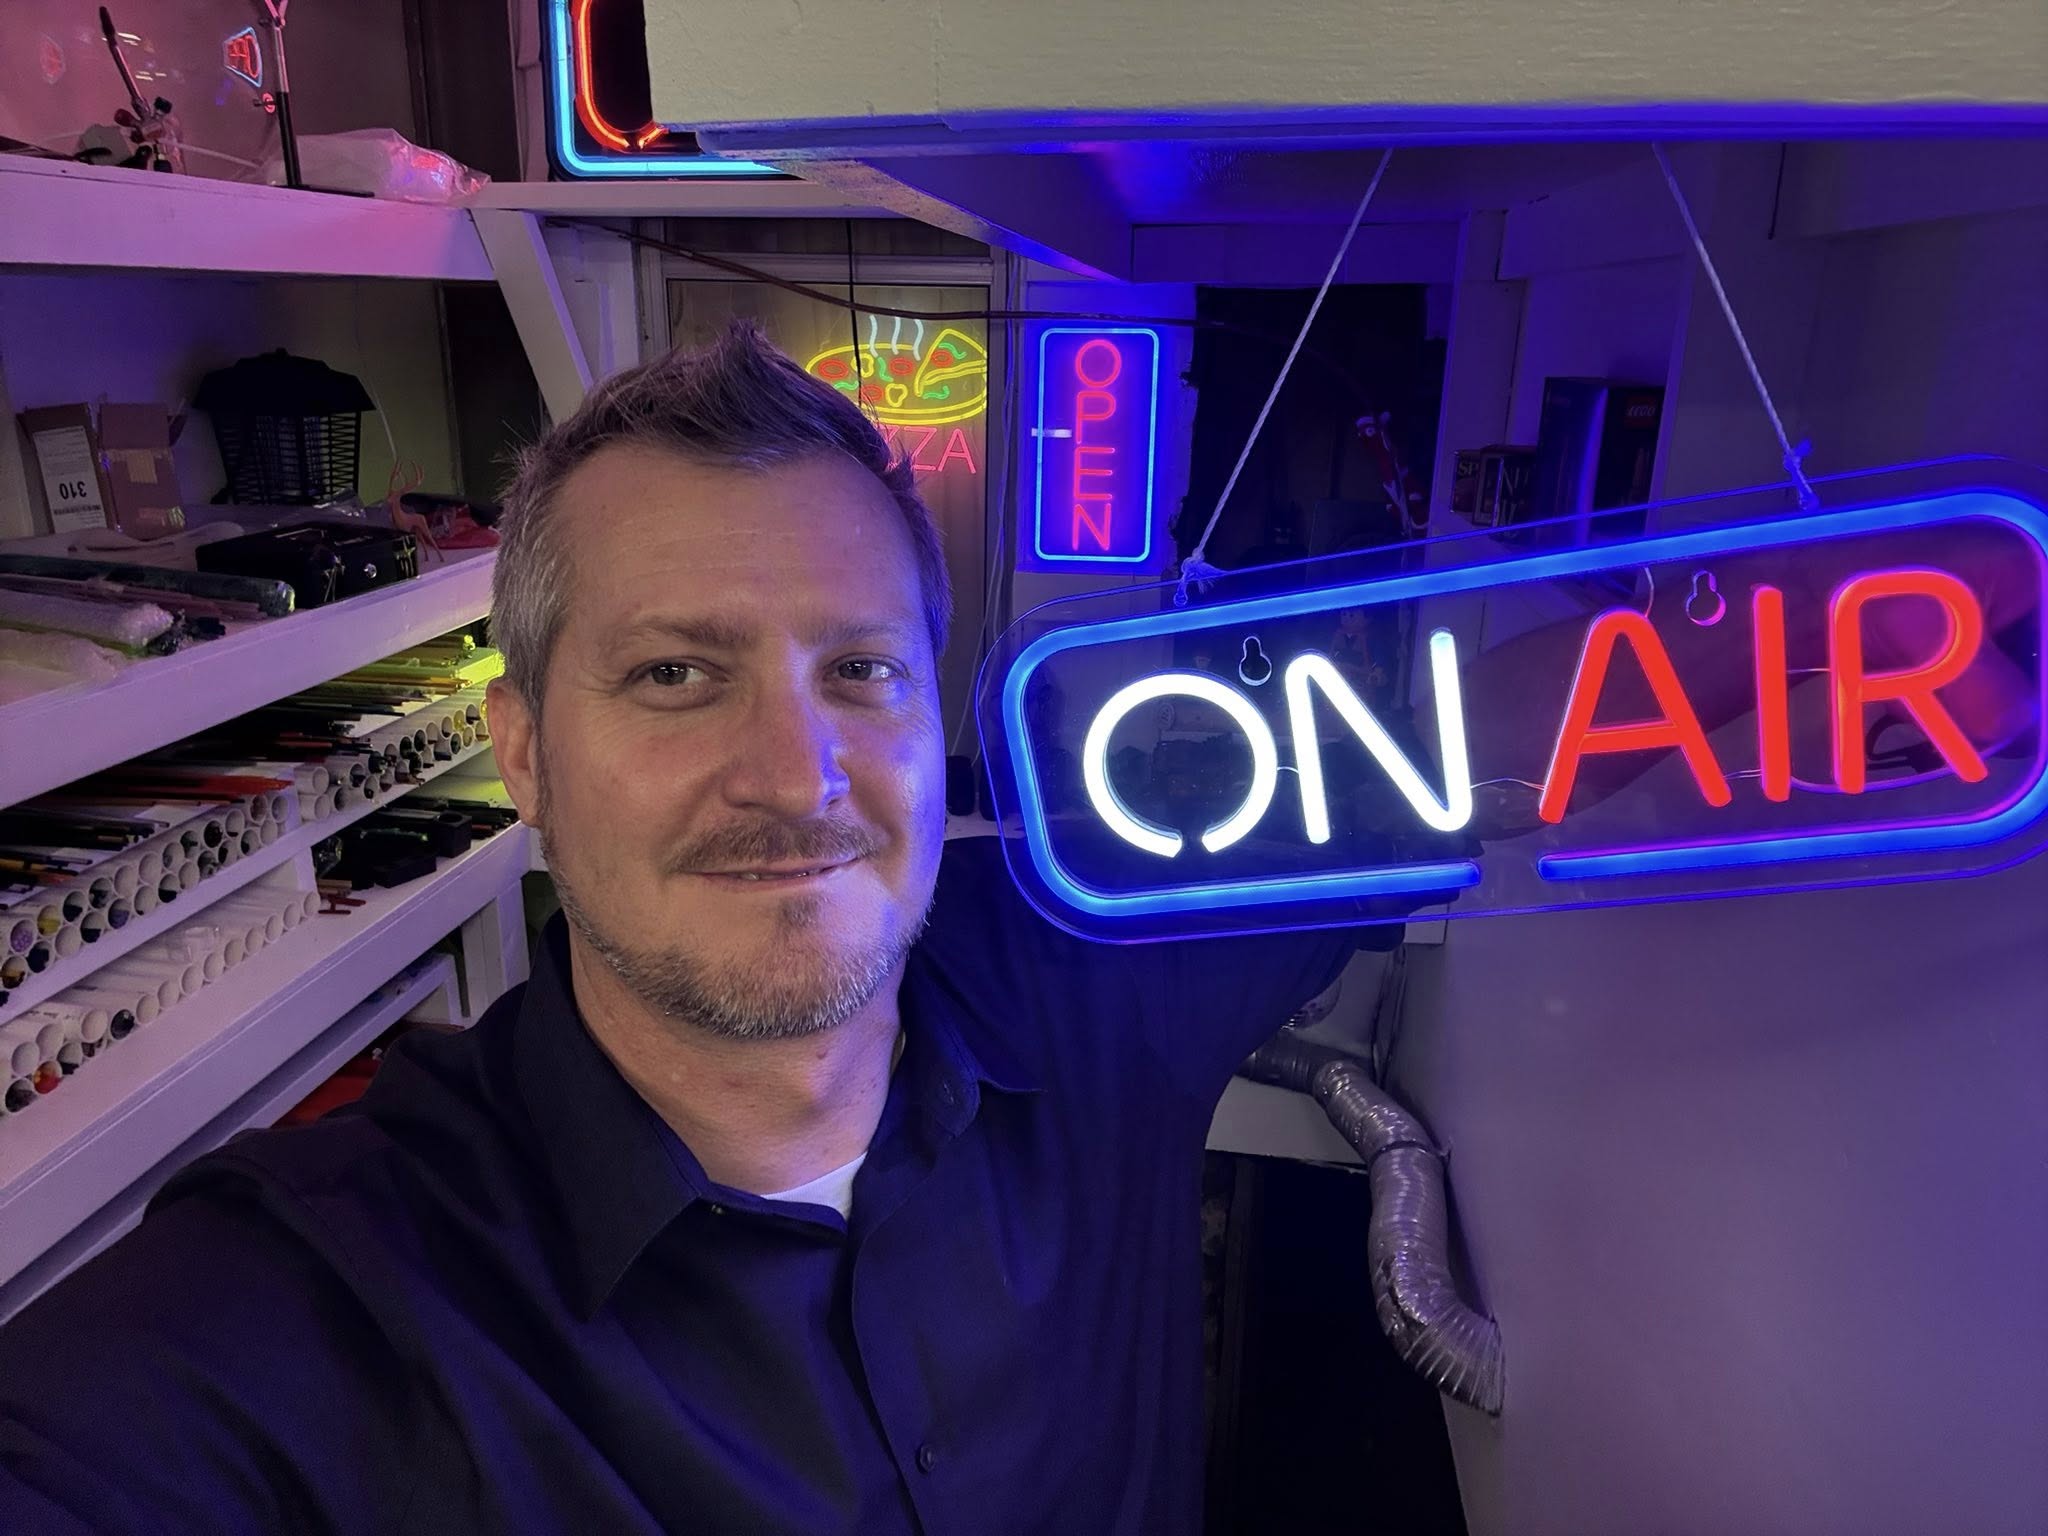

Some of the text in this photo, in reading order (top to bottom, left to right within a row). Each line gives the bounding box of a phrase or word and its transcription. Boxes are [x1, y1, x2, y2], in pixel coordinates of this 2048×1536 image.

[59, 481, 87, 500] 310
[879, 425, 976, 473] ZZA
[1073, 339, 1122, 550] OPEN
[1083, 568, 1989, 858] ON AIR
